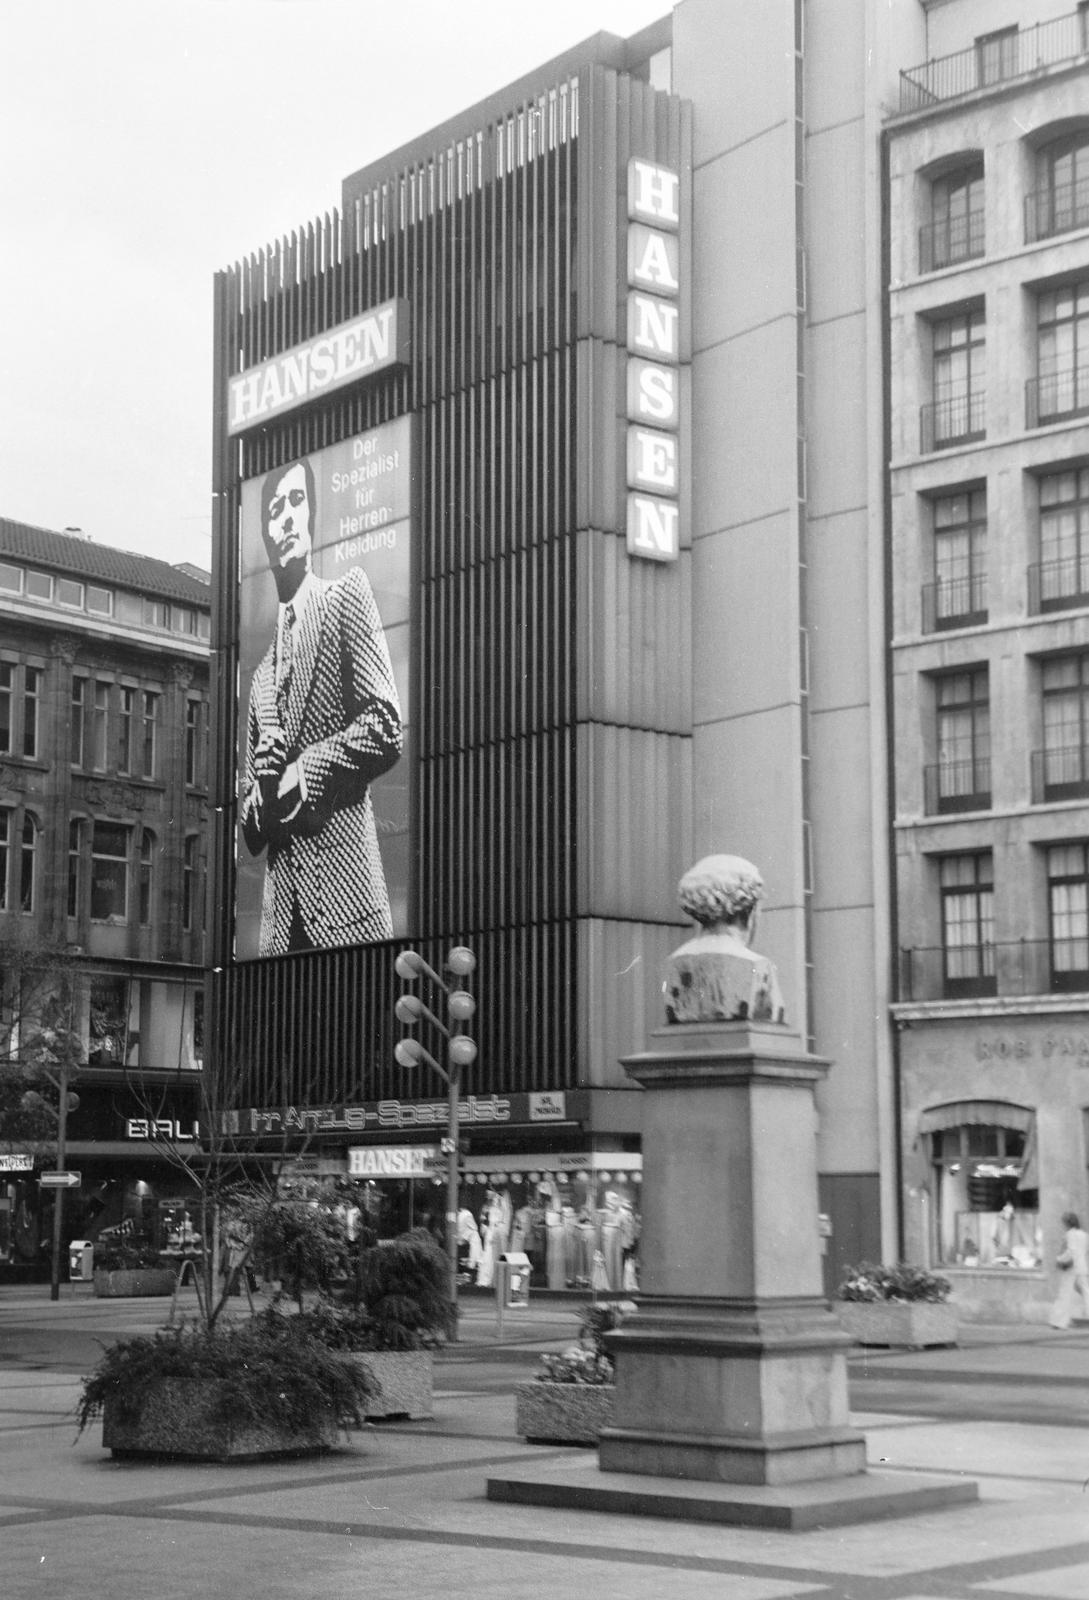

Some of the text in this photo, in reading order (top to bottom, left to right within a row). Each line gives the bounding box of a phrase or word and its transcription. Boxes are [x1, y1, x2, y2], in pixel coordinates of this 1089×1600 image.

[232, 308, 392, 427] HANSEN
[634, 160, 679, 553] HANSEN
[353, 437, 378, 460] Der
[331, 450, 399, 493] Spezialist
[355, 487, 375, 508] für
[340, 506, 393, 537] Herren-
[335, 528, 396, 563] Kleidung
[281, 1094, 511, 1130] Anzug-Spezalist
